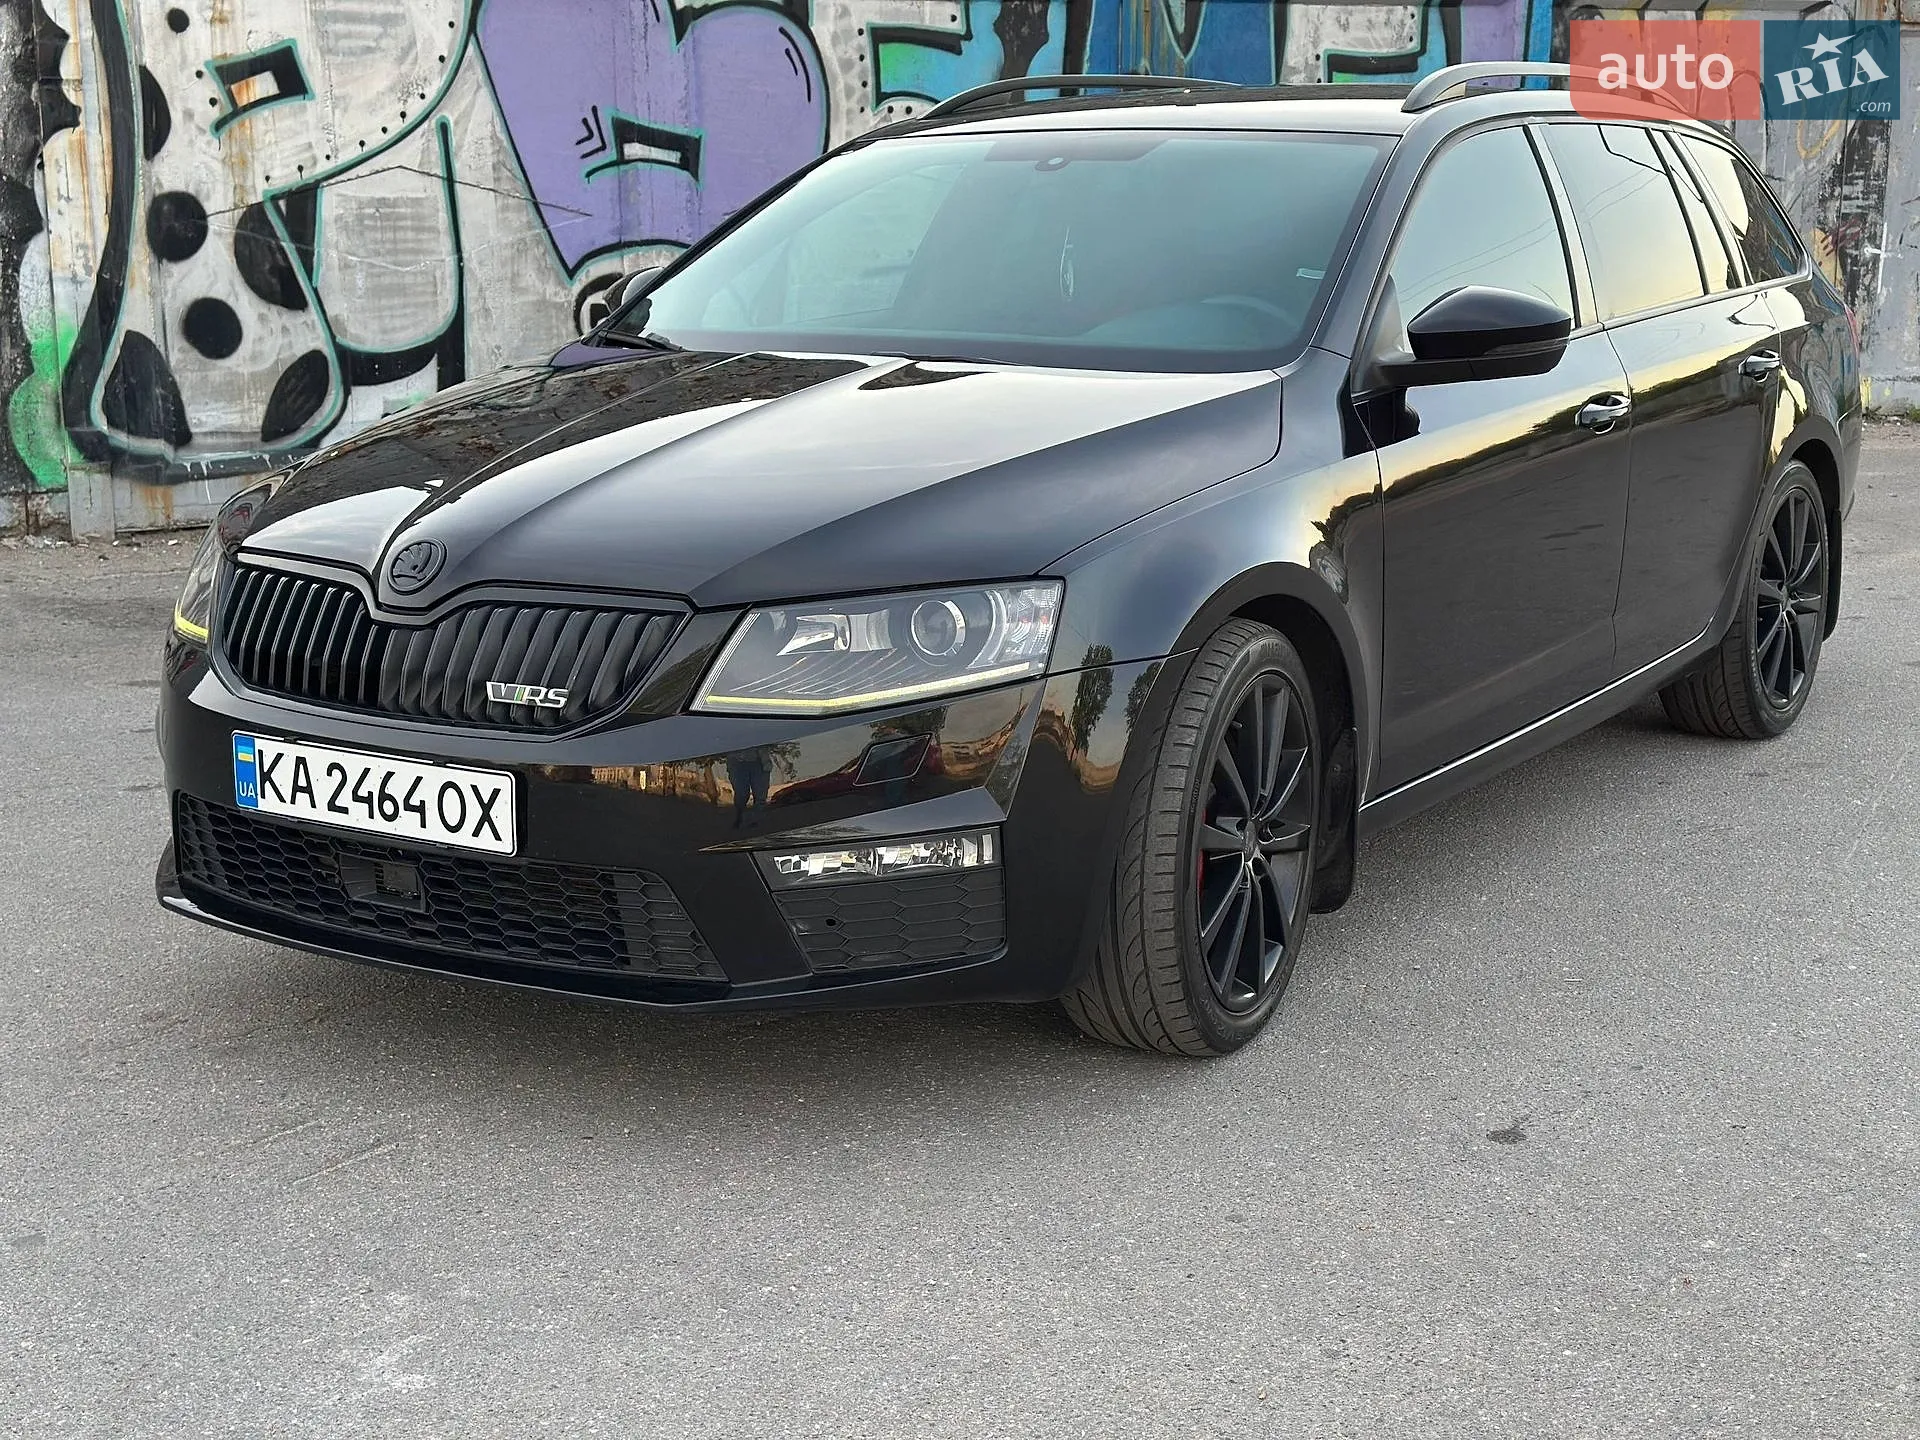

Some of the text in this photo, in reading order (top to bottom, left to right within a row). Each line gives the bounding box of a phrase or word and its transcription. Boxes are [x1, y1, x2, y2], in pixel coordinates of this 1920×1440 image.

[239, 781, 256, 799] UA
[257, 748, 503, 842] KA 2464 OX
